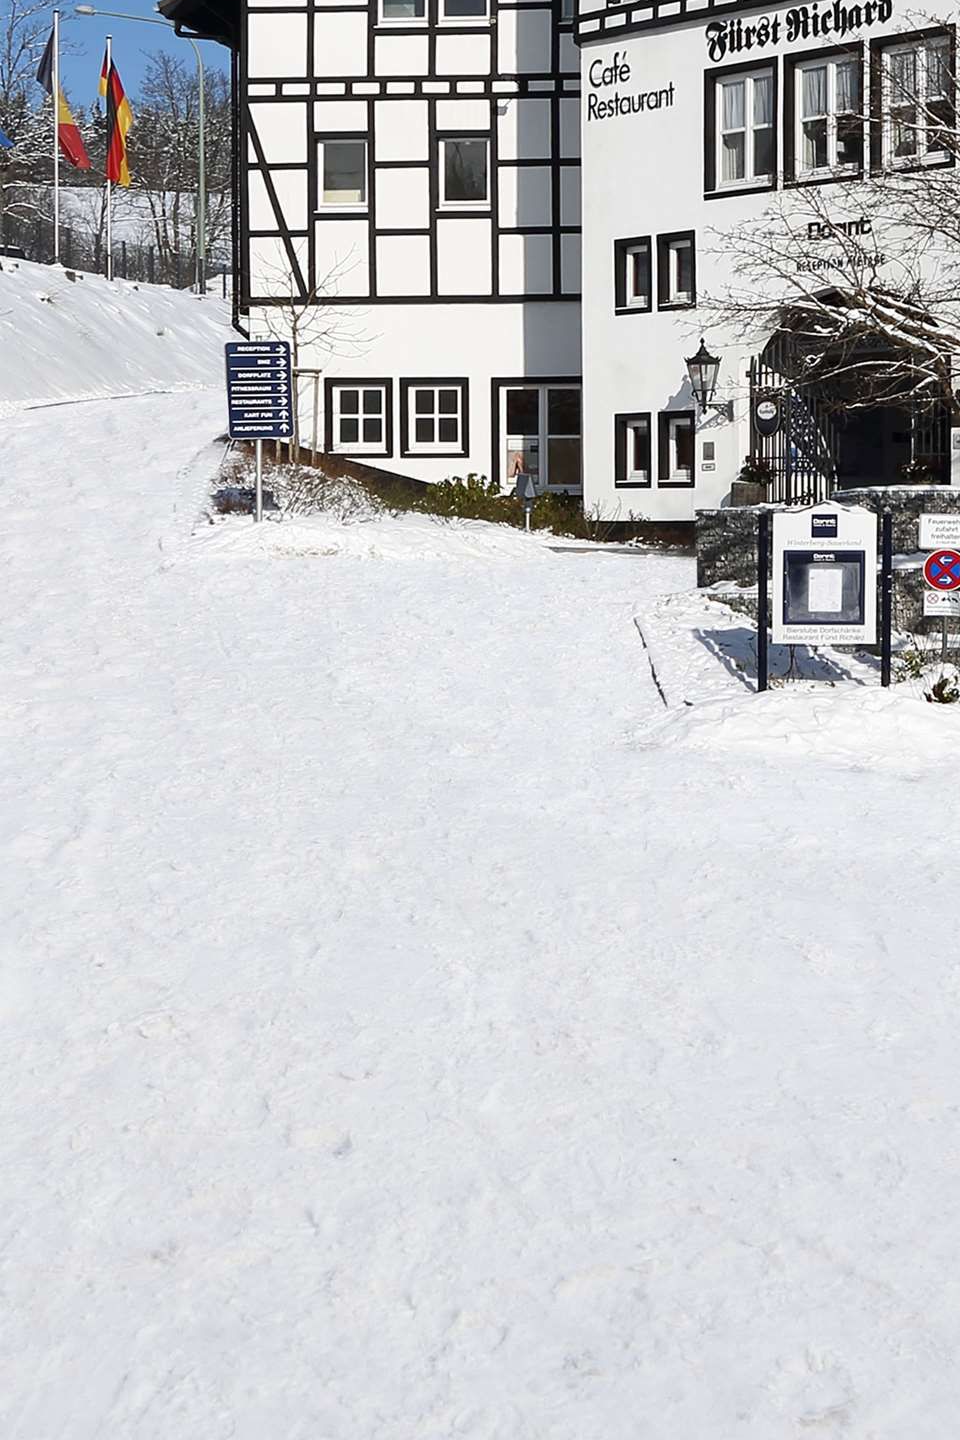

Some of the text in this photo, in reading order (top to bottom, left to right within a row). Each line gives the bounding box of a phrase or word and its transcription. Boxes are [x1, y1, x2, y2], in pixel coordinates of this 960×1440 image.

[705, 13, 783, 62] Fürst
[589, 51, 631, 89] Café
[587, 81, 675, 121] Restaurant
